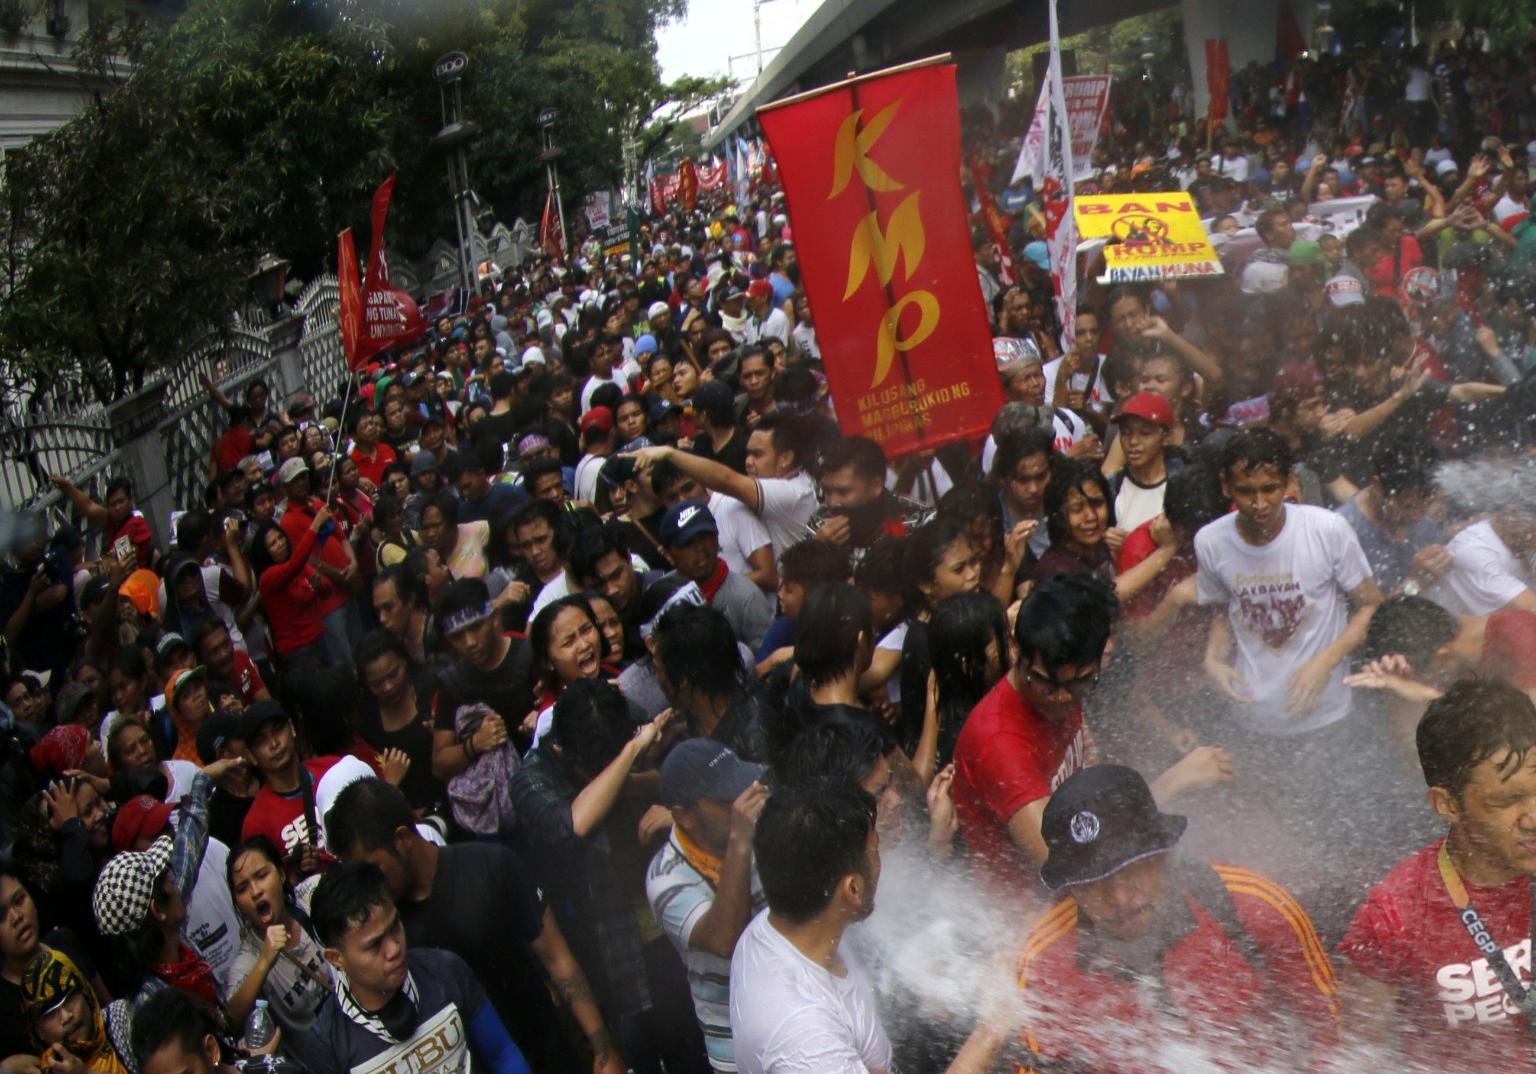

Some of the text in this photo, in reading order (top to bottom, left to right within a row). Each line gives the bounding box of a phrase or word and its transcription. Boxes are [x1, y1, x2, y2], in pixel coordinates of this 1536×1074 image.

[1077, 201, 1193, 215] BAN
[1112, 241, 1207, 257] RUMP
[1110, 261, 1216, 282] BAYAN MUNA
[858, 379, 926, 411] KILUSANG
[951, 382, 971, 400] NG
[1461, 909, 1497, 955] CEGP
